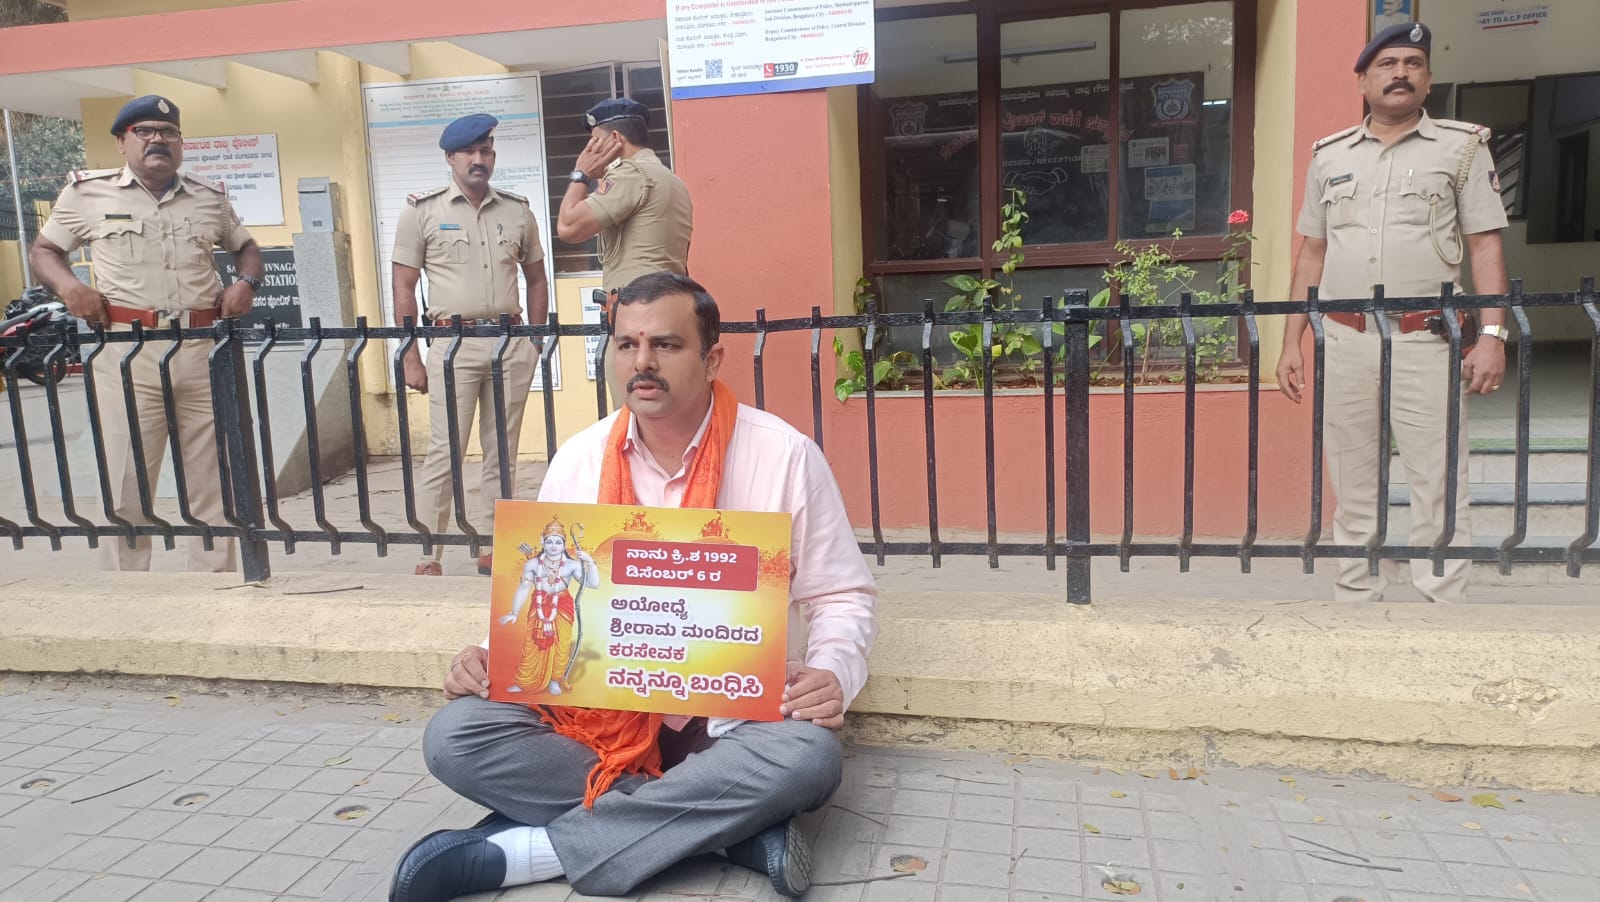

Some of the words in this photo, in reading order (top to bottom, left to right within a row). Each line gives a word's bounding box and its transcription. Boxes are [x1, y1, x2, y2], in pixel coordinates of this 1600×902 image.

[1523, 11, 1547, 20] OFFICE
[775, 63, 795, 73] 1930
[855, 52, 869, 66] 112
[264, 274, 298, 287] STATIO
[626, 546, 668, 561] ನಾನು
[671, 549, 700, 566] ಕ್ರಿ.ಶ
[704, 550, 737, 564] 1992
[625, 566, 694, 582] ಡಿಸೆಂಬರ್
[697, 570, 705, 583] 6
[708, 571, 721, 582] ರ
[611, 596, 688, 620] ಅಯೋಧ್ಯೆ
[610, 618, 676, 638] ಶ್ರೀರಾಮ
[681, 624, 759, 642] ಮಂದಿರದ
[608, 642, 686, 661] ಕರಸೇವಕ
[608, 669, 687, 697] ನನ್ನನ್ನೂ
[690, 675, 760, 697] ಬಂಧಿಸಿ
